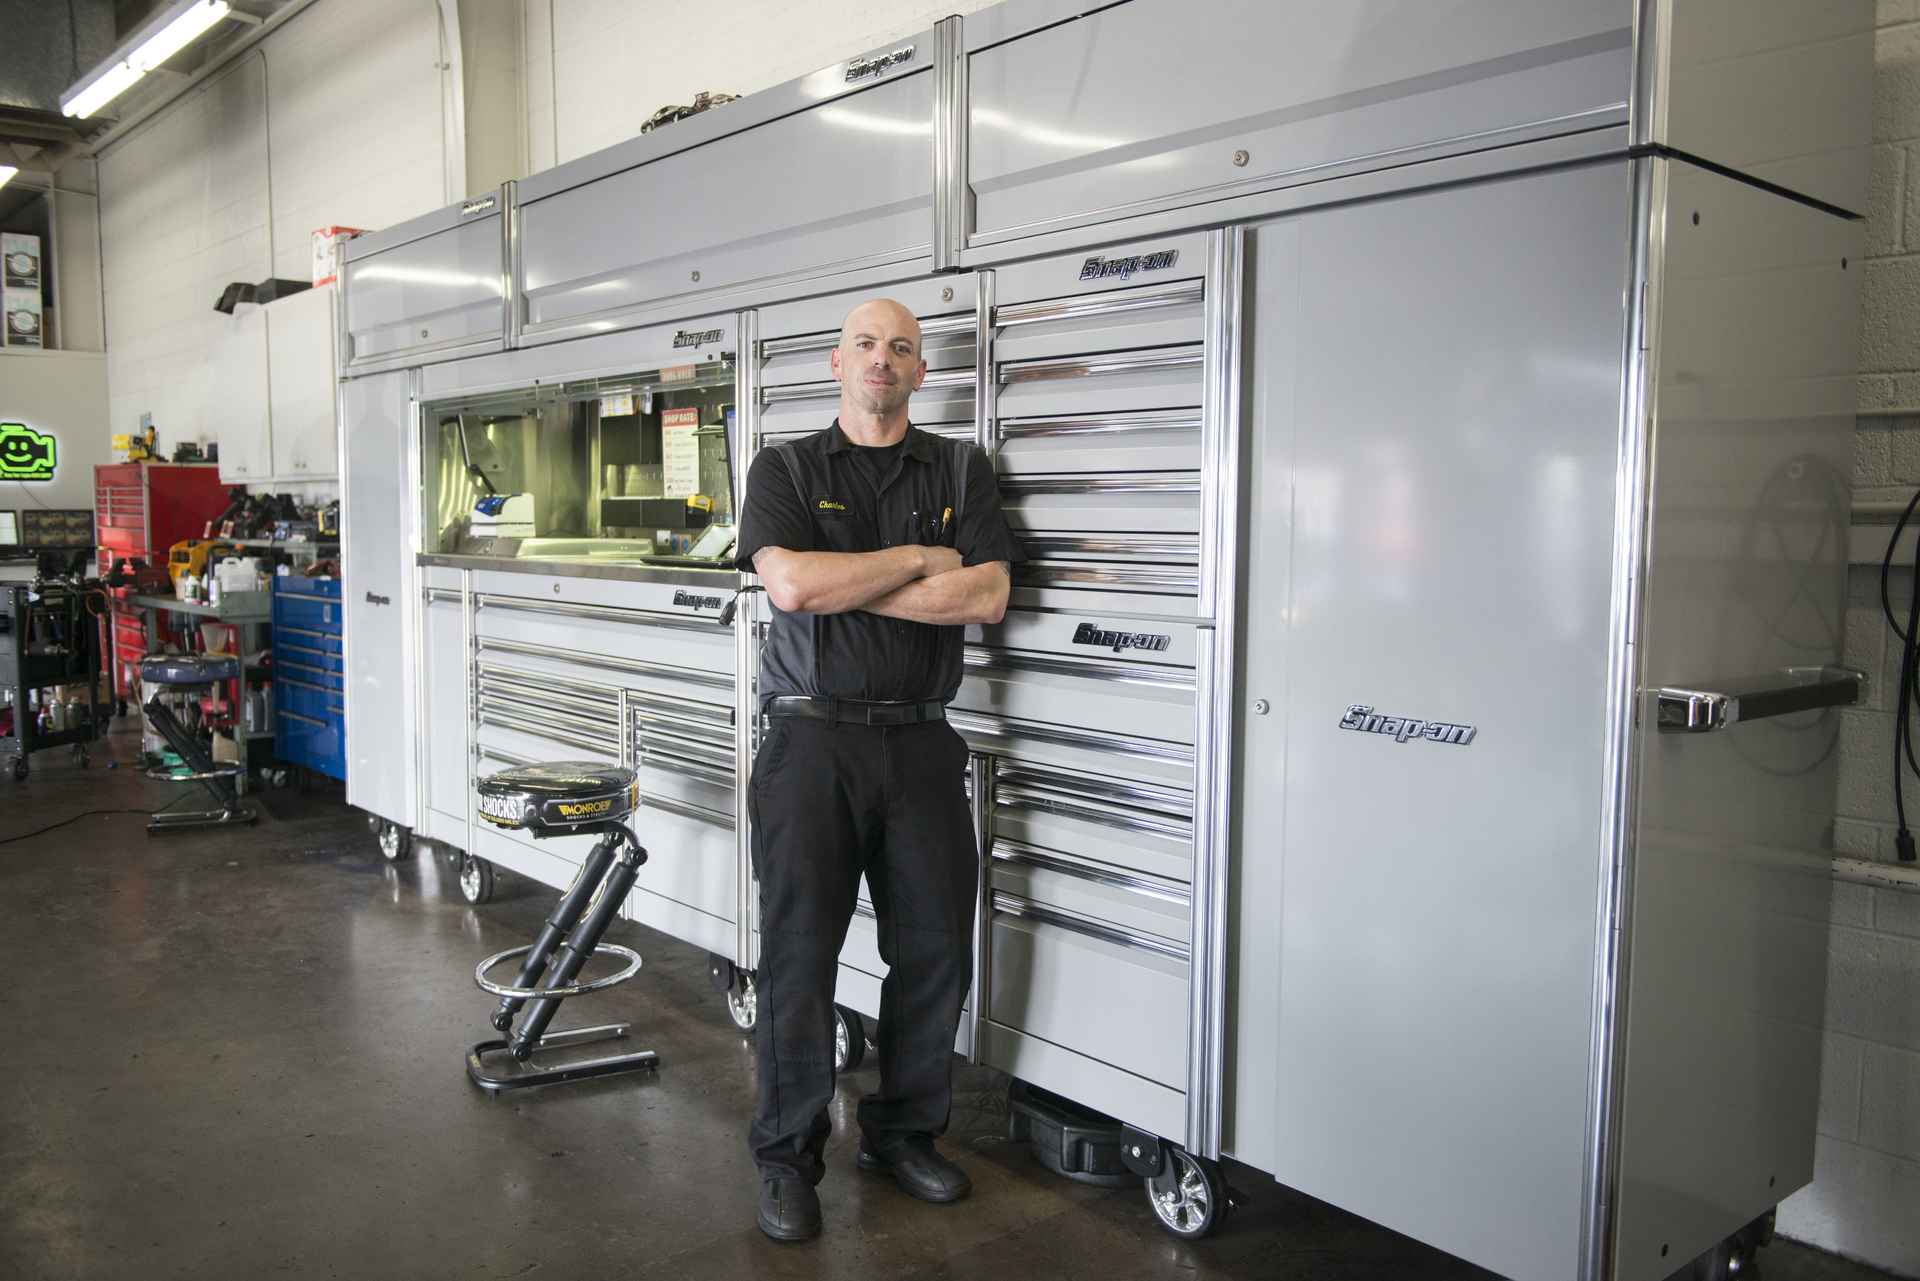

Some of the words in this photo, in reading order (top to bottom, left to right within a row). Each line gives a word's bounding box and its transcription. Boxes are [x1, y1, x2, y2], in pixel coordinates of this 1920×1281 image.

[845, 45, 916, 82] Snap-on
[1079, 250, 1179, 280] Snap-on
[673, 329, 724, 349] Snap-on
[664, 413, 679, 424] SHOP
[819, 500, 846, 510] Charles
[673, 590, 724, 611] Snap-on
[1072, 622, 1170, 653] Snap-on
[1339, 704, 1476, 745] Snap-on
[483, 795, 520, 820] SHOCKS.
[565, 801, 606, 816] MONROE
